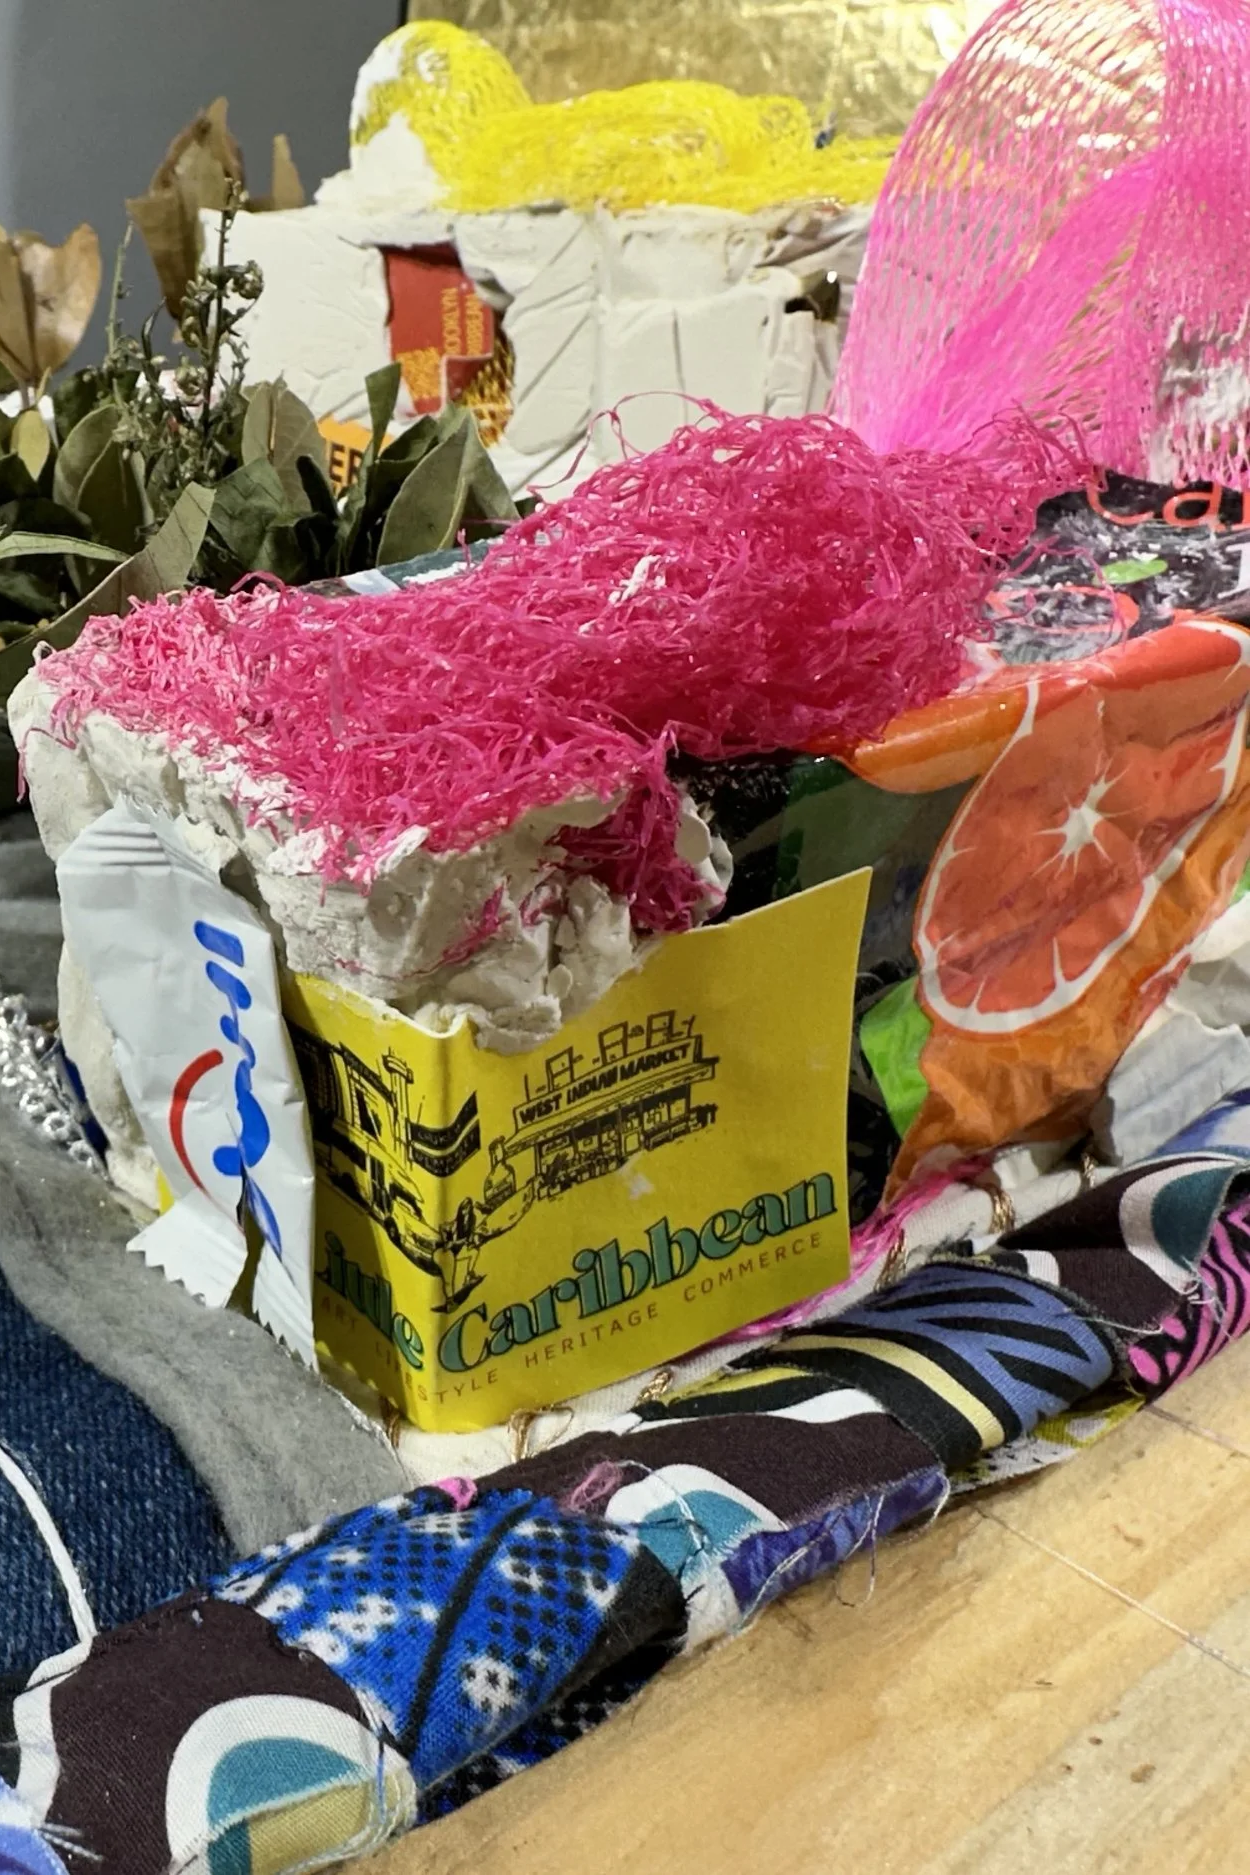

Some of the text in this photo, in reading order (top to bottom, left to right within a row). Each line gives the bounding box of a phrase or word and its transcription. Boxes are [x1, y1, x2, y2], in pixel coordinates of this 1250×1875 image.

[519, 1042, 692, 1124] WEST INDIAN MARKET
[315, 1172, 838, 1373] ittle Caribbean
[524, 1301, 660, 1369] HERITAGE
[682, 1231, 823, 1303] COMMERCE
